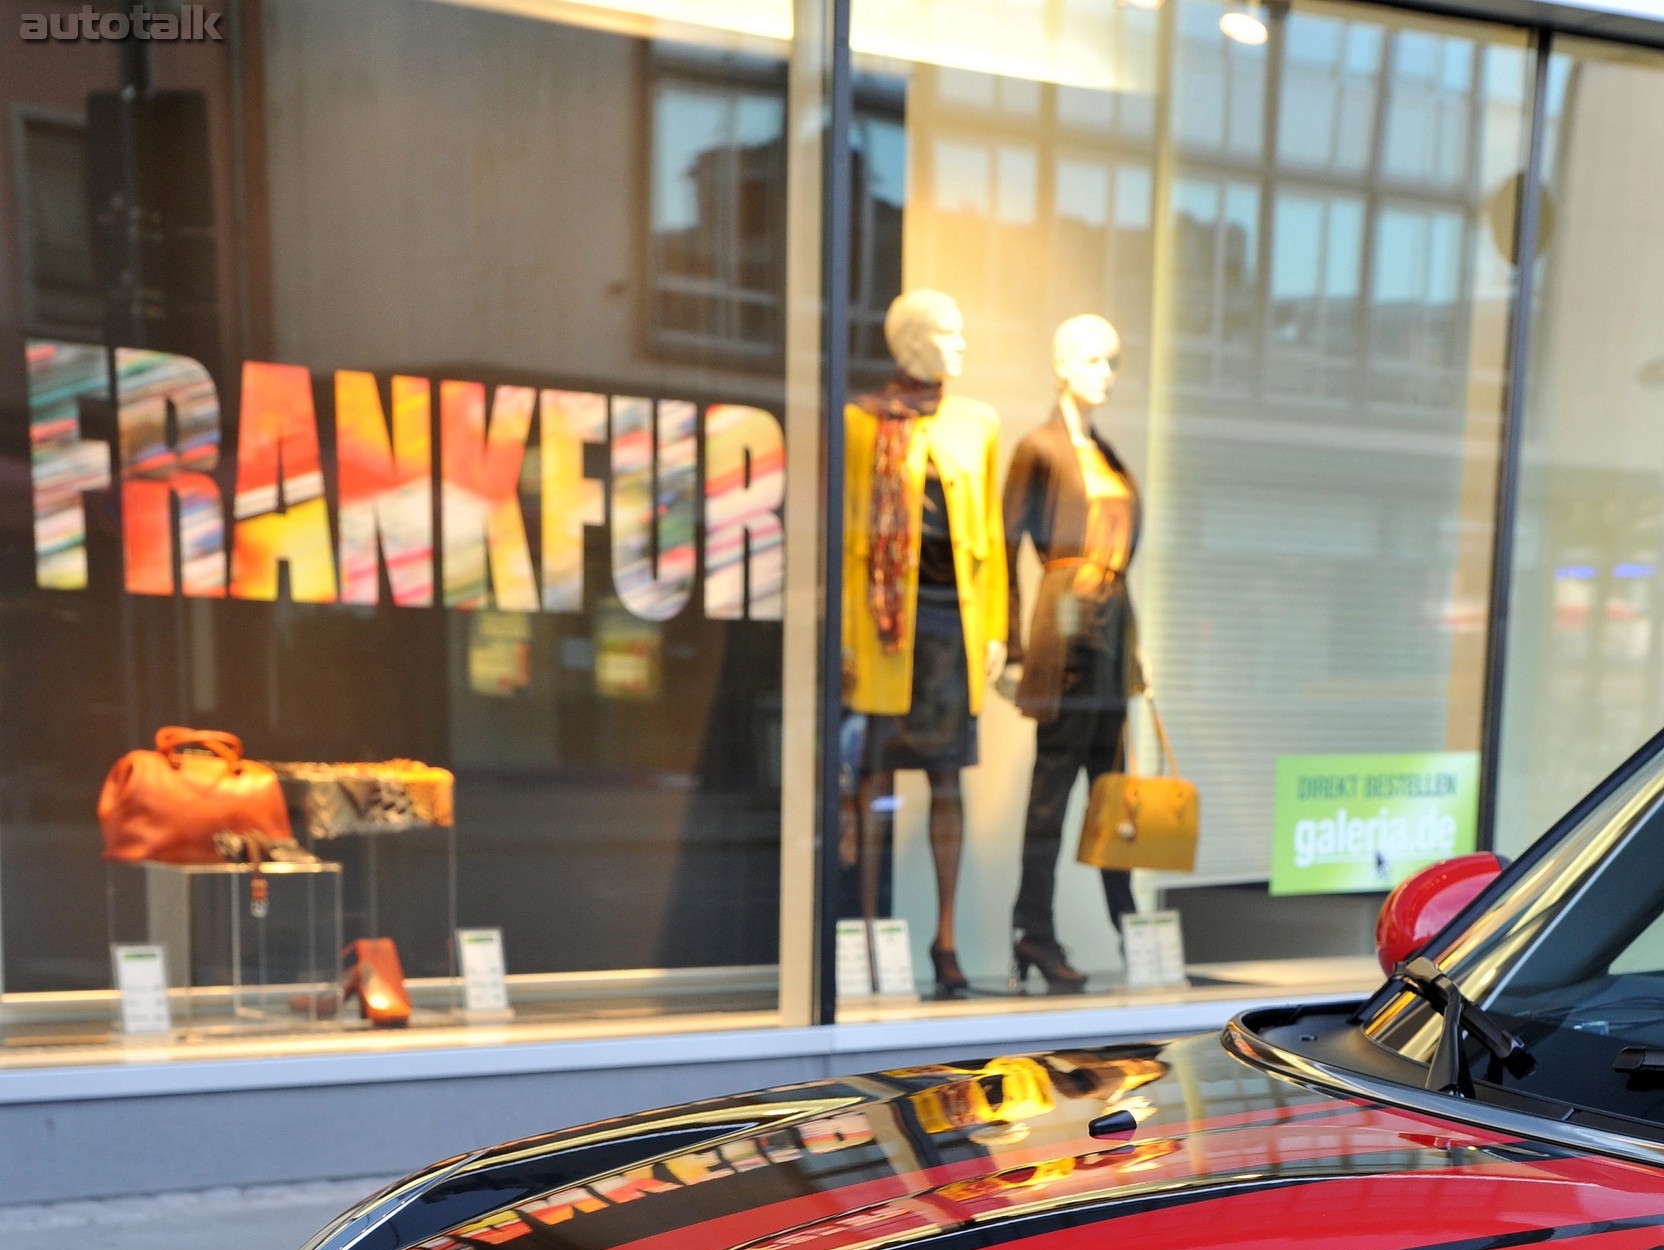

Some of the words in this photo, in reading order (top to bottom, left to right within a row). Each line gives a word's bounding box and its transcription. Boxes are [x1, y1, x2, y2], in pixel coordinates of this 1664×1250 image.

[1297, 774, 1359, 798] DIREKT
[1365, 771, 1459, 797] BESTELLEN
[1294, 807, 1457, 869] galeria.de
